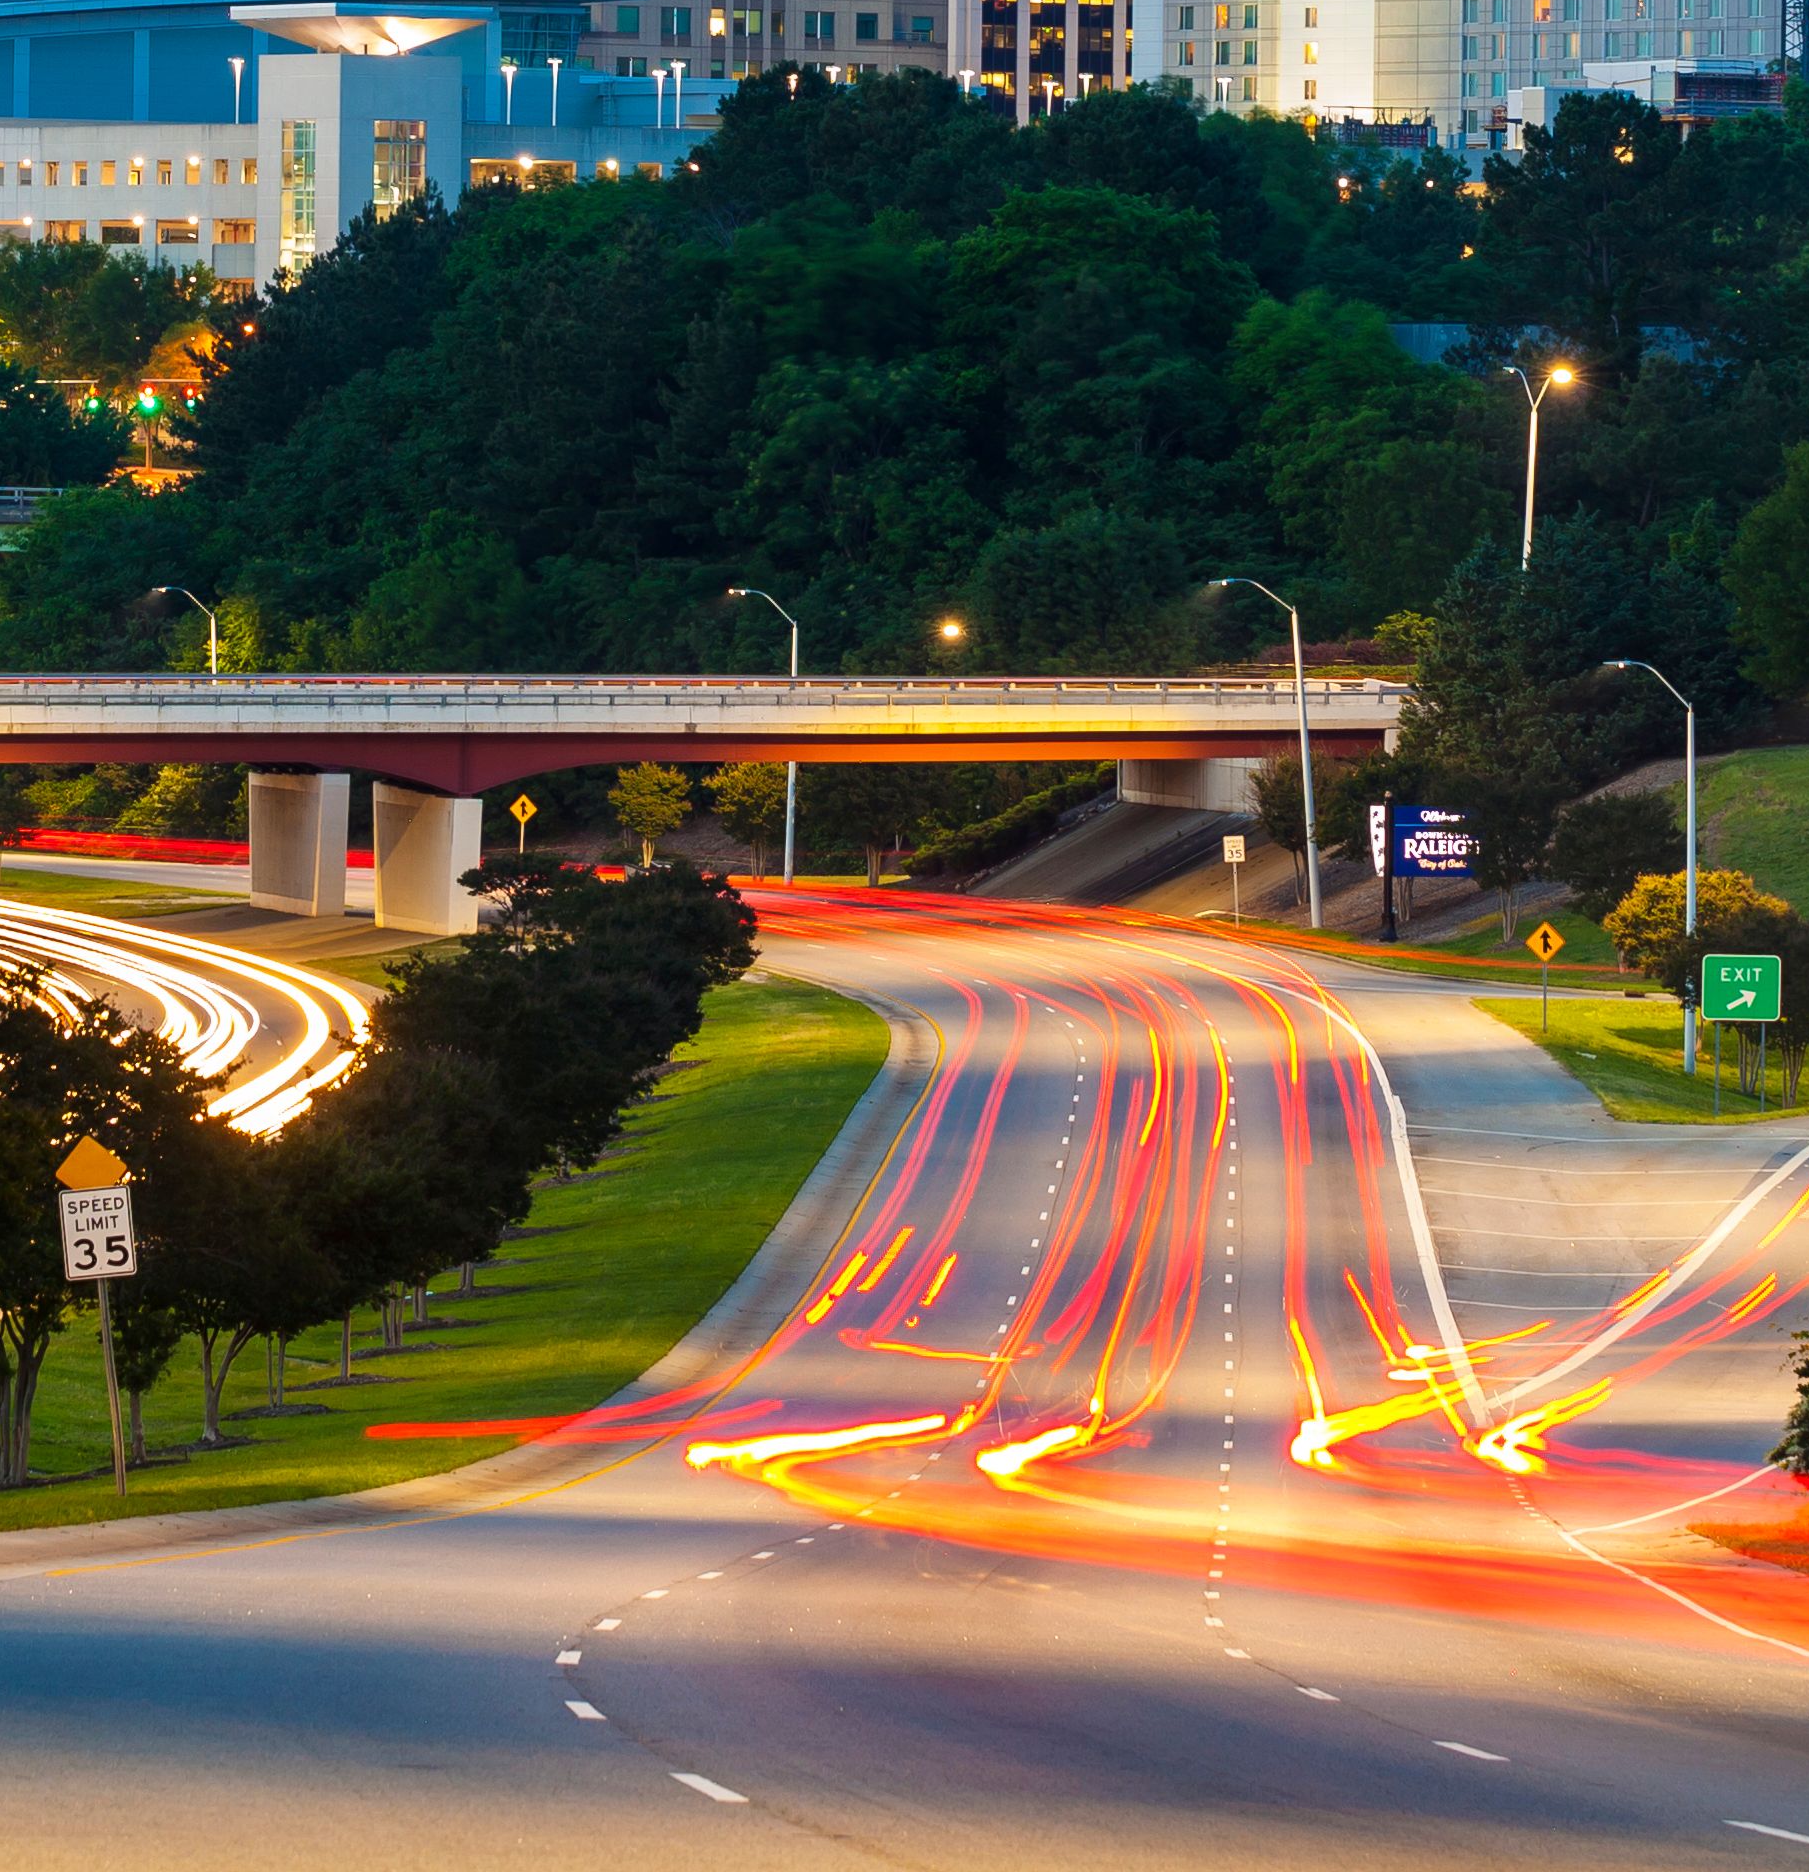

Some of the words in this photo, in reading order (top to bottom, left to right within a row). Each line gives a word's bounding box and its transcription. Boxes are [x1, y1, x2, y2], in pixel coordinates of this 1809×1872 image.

[1227, 849, 1243, 859] 35
[1721, 967, 1763, 982] EXIT
[67, 1196, 125, 1215] SPEED
[75, 1215, 119, 1233] LIMIT
[73, 1234, 130, 1271] 35
